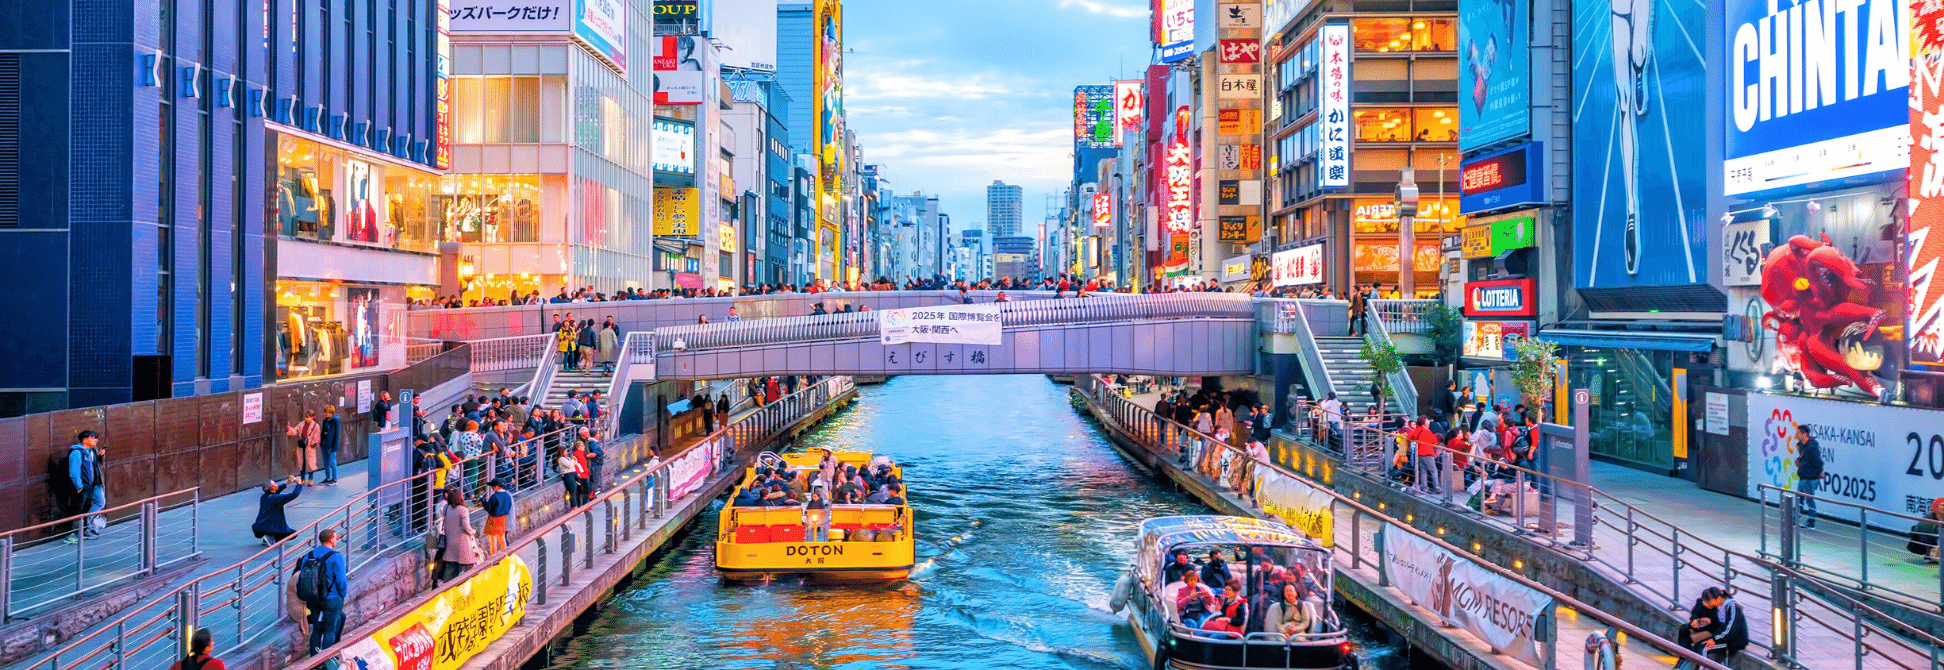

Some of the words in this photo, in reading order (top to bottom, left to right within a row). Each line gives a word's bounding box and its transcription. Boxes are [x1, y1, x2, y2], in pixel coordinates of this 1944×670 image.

[1221, 78, 1257, 91] 白木屋
[1329, 51, 1344, 102] 本場の味
[1328, 108, 1345, 181] かに道楽
[1165, 142, 1190, 232] 大阪王将
[1481, 288, 1519, 308] LOTTERIA
[912, 311, 945, 321] 2025年
[948, 311, 1001, 322] 国際博覧会を
[912, 325, 959, 335] 大阪・関西へ
[888, 350, 986, 365] えびす橋
[1808, 423, 1876, 448] OSAKA-KANSAI
[786, 544, 843, 556] DOTON
[1450, 577, 1483, 616] MGM
